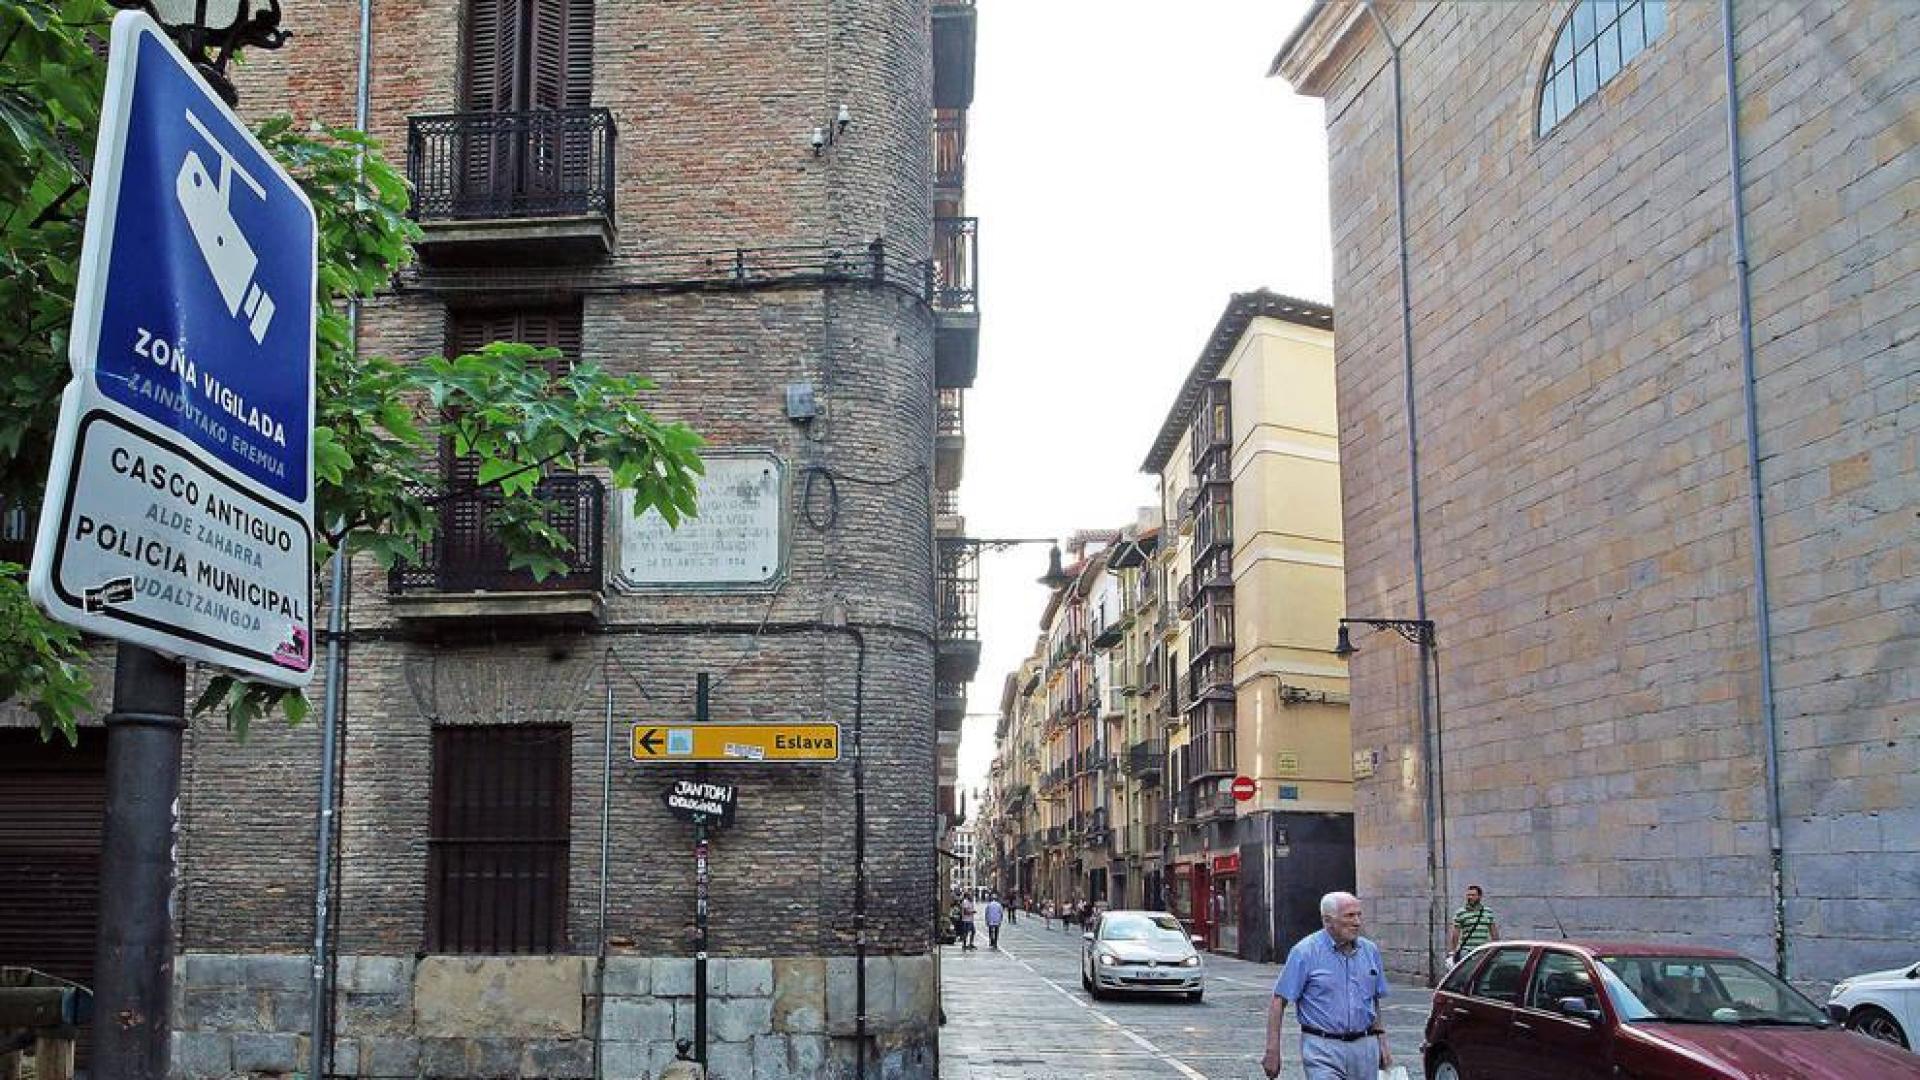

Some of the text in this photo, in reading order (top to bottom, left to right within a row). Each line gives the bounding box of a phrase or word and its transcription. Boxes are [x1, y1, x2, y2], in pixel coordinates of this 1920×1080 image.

[127, 372, 285, 477] ZAINDUTAKO EREMUA
[135, 327, 286, 447] ZONA VIGILADA
[111, 447, 292, 552] CASCO ANTIGUO
[145, 503, 263, 570] ALDE ZAHARRA
[75, 515, 188, 577] POLICIA
[197, 559, 304, 622] MUNICIPAL
[134, 576, 261, 631] UDALTZAINGOA
[775, 734, 833, 749] Eslava
